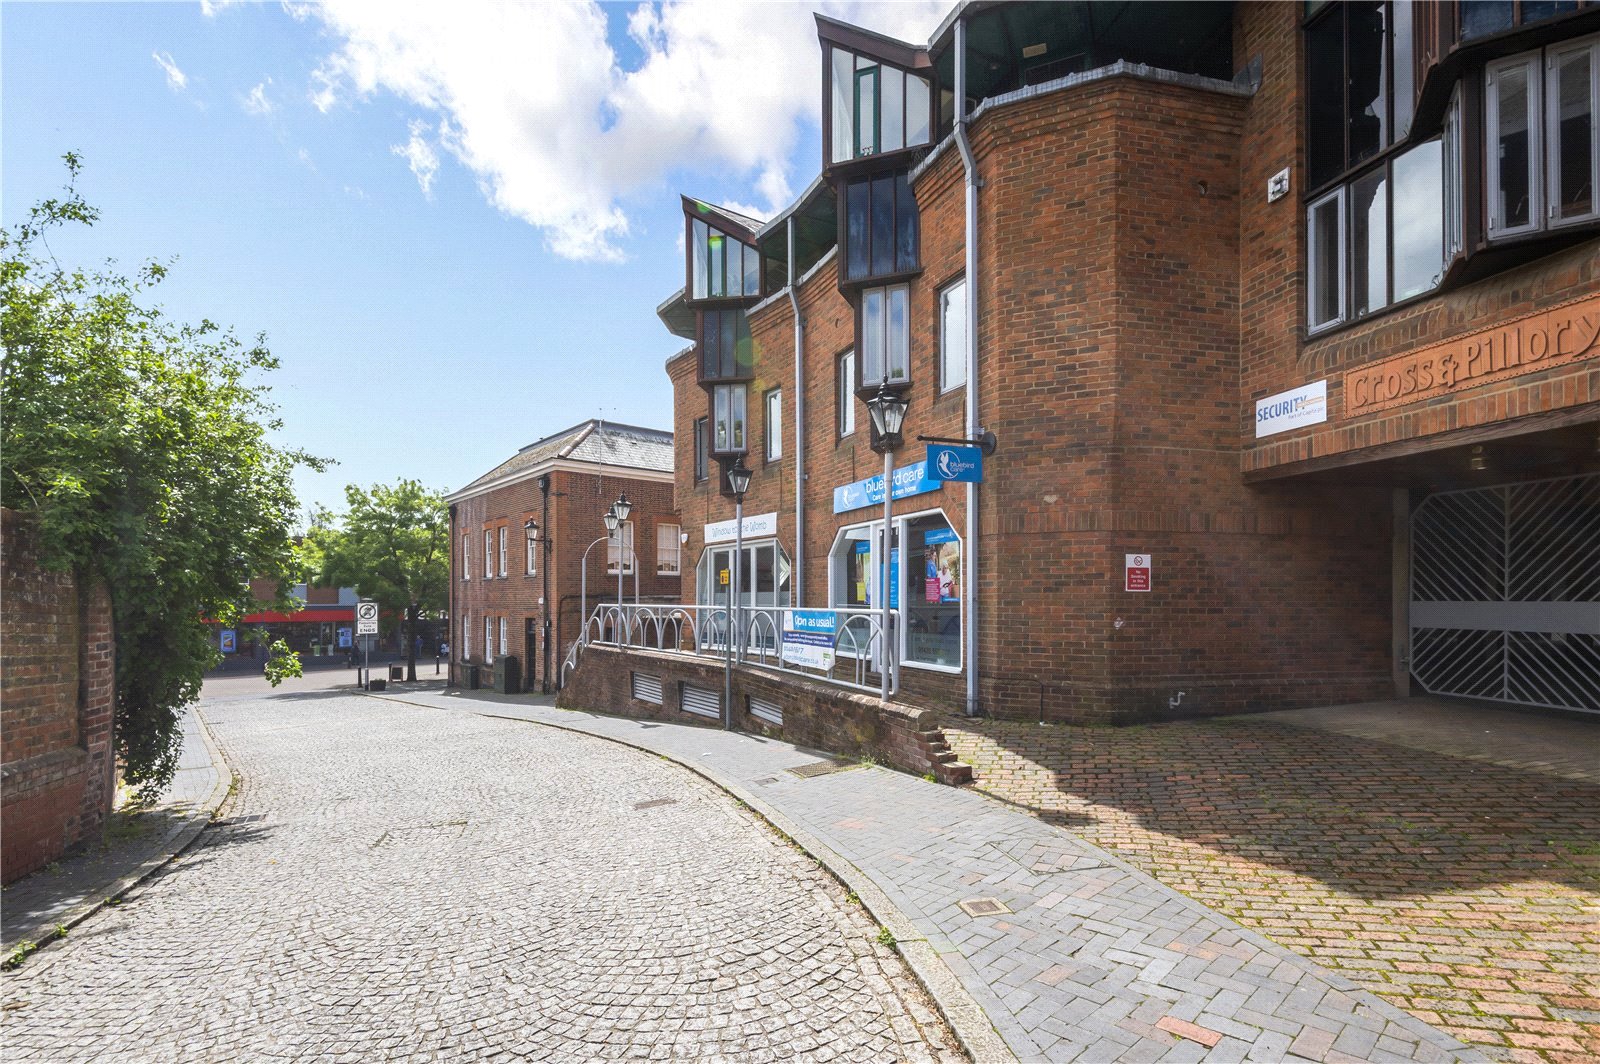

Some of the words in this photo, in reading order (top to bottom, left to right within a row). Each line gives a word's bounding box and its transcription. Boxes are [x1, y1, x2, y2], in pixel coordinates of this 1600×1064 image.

[1257, 395, 1307, 423] SECURITY
[950, 461, 975, 469] bluebird
[902, 468, 924, 483] care
[808, 617, 816, 627] as
